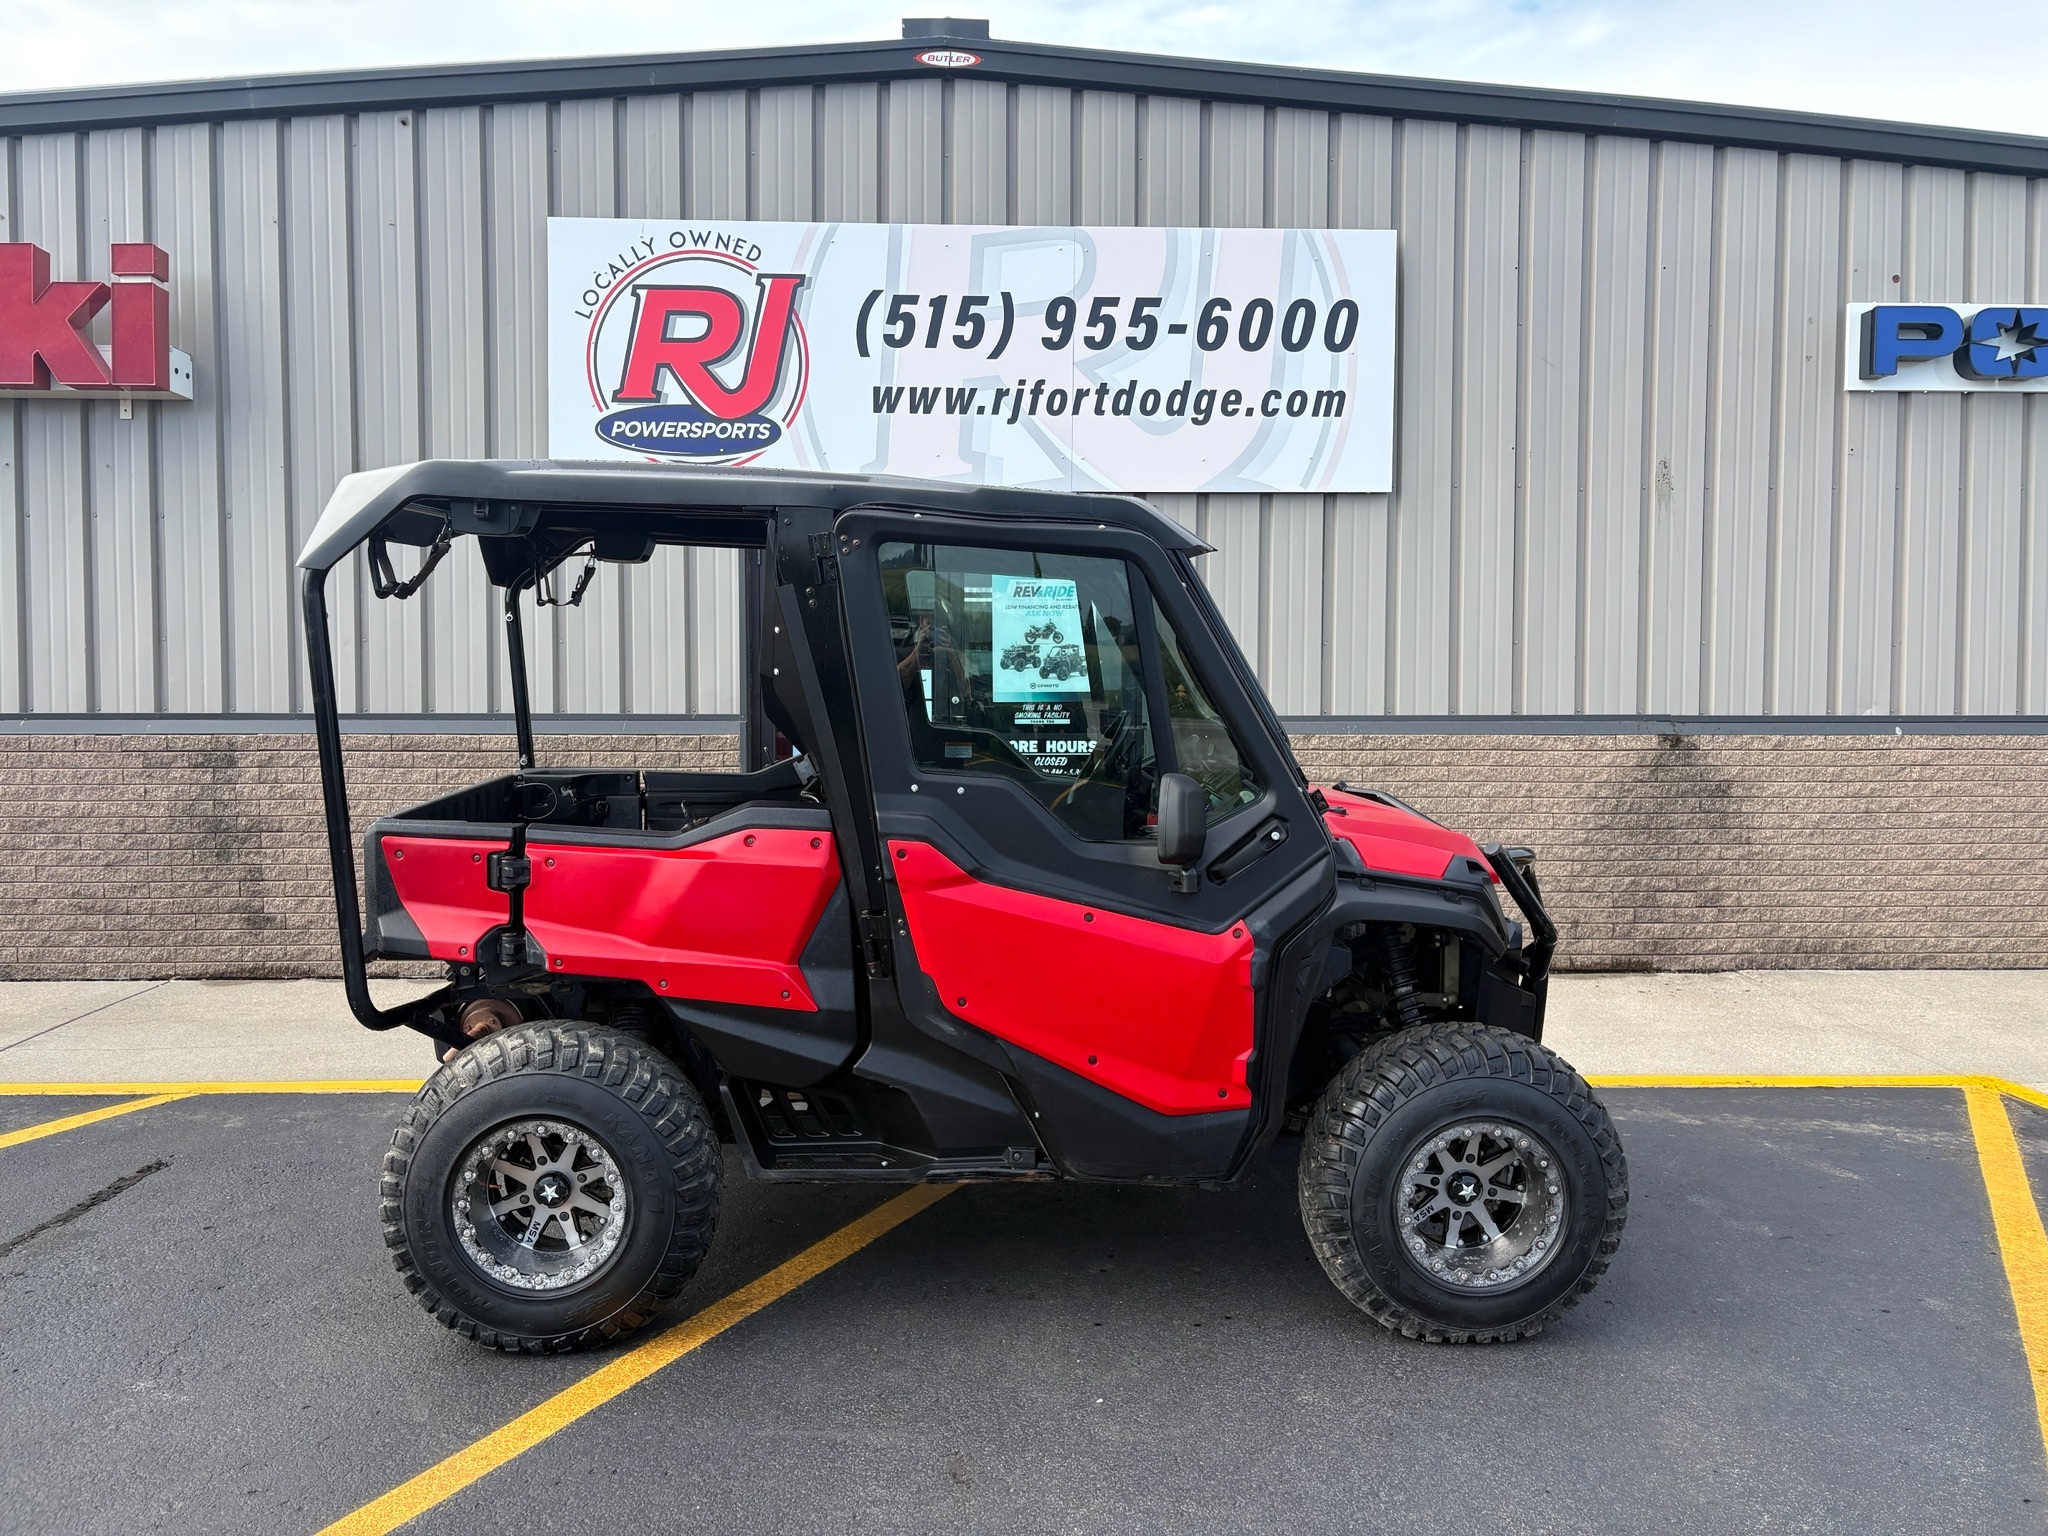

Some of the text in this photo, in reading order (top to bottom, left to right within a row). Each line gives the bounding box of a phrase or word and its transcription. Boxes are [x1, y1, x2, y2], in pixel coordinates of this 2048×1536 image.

[927, 54, 971, 63] BUTLER
[574, 229, 762, 320] LOCALLY OWNED
[0, 242, 170, 391] ki
[855, 289, 1361, 360] (515) 955-6000
[611, 273, 808, 420] RJ
[872, 378, 1348, 426] www.rjfortdodge.com
[611, 420, 771, 440] POWERSPORTS
[1014, 711, 1071, 719] SMOKING FACILITY
[1045, 740, 1098, 753] HOURS
[1034, 756, 1068, 766] CLOSED
[1414, 1204, 1435, 1222] MSA
[525, 1220, 541, 1243] MSA
